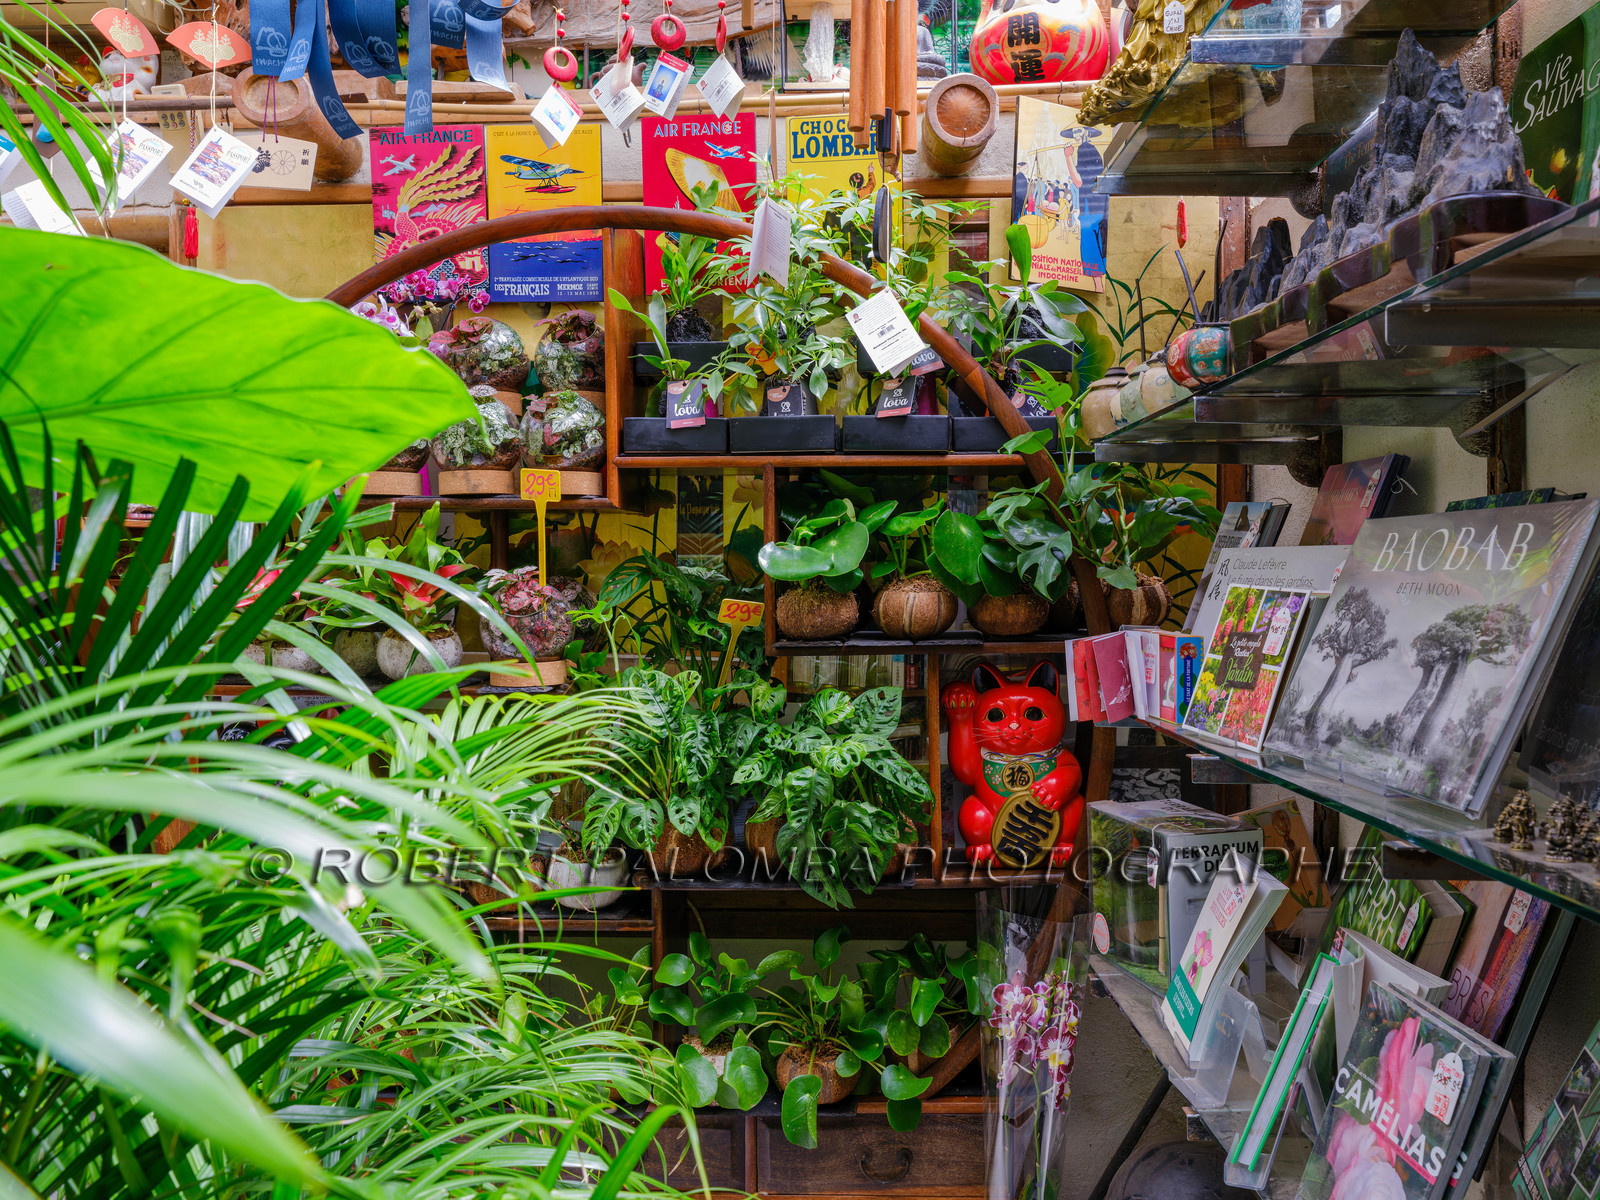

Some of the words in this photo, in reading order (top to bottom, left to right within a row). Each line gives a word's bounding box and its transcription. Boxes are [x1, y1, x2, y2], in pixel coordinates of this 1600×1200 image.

[255, 59, 285, 67] IWACH
[380, 131, 407, 145] AIR
[412, 129, 473, 144] FRANCE
[654, 122, 678, 138] AIR
[682, 120, 742, 137] FRANCE
[1031, 254, 1059, 265] OSITION
[1060, 258, 1099, 270] NATIONALE
[1038, 271, 1079, 283] INDOCHINE
[504, 283, 550, 297] FRANÇAIS
[1371, 522, 1535, 572] BAOBAB
[1233, 558, 1258, 570] Claude
[1396, 582, 1424, 595] BETH
[1426, 583, 1464, 597] MOON
[722, 603, 762, 622] 29€
[1220, 654, 1254, 690] Jardin
[1173, 840, 1259, 860] TERRARIUM
[1204, 859, 1223, 873] DI
[1335, 1067, 1447, 1178] CAMÉLIAS
